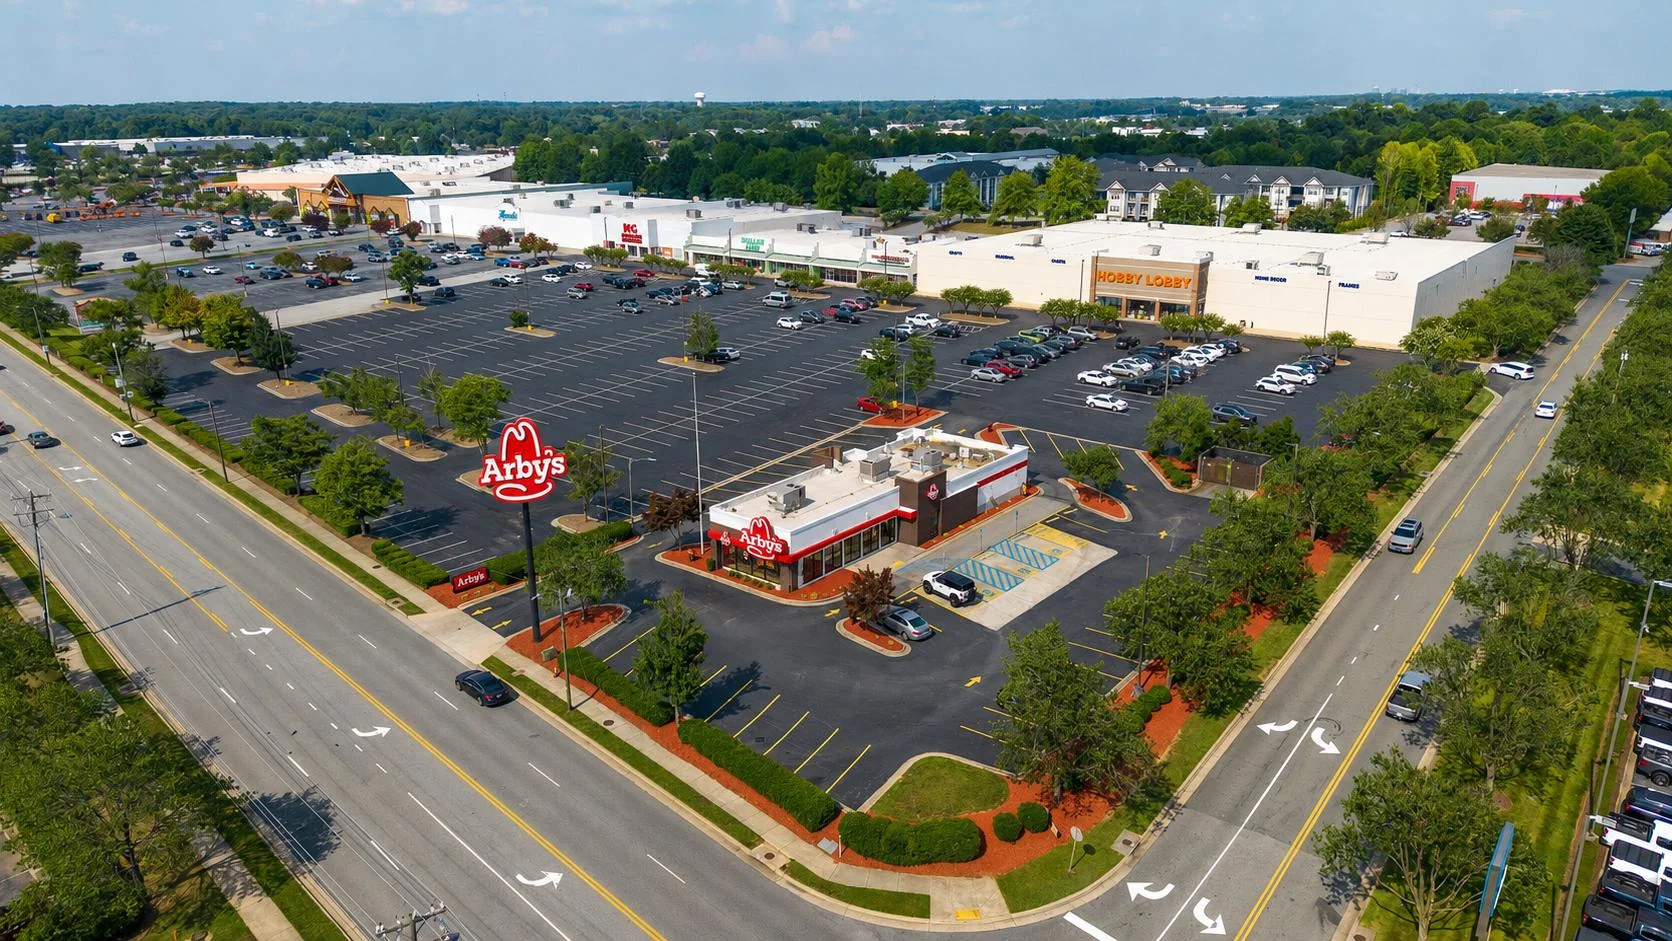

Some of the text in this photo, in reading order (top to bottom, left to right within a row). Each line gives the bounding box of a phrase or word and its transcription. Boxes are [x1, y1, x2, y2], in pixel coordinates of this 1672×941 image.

[1096, 271, 1192, 289] HOBBY LOBBY
[481, 449, 566, 485] Arby's
[739, 530, 783, 554] Arby's
[457, 572, 485, 588] Arby's
